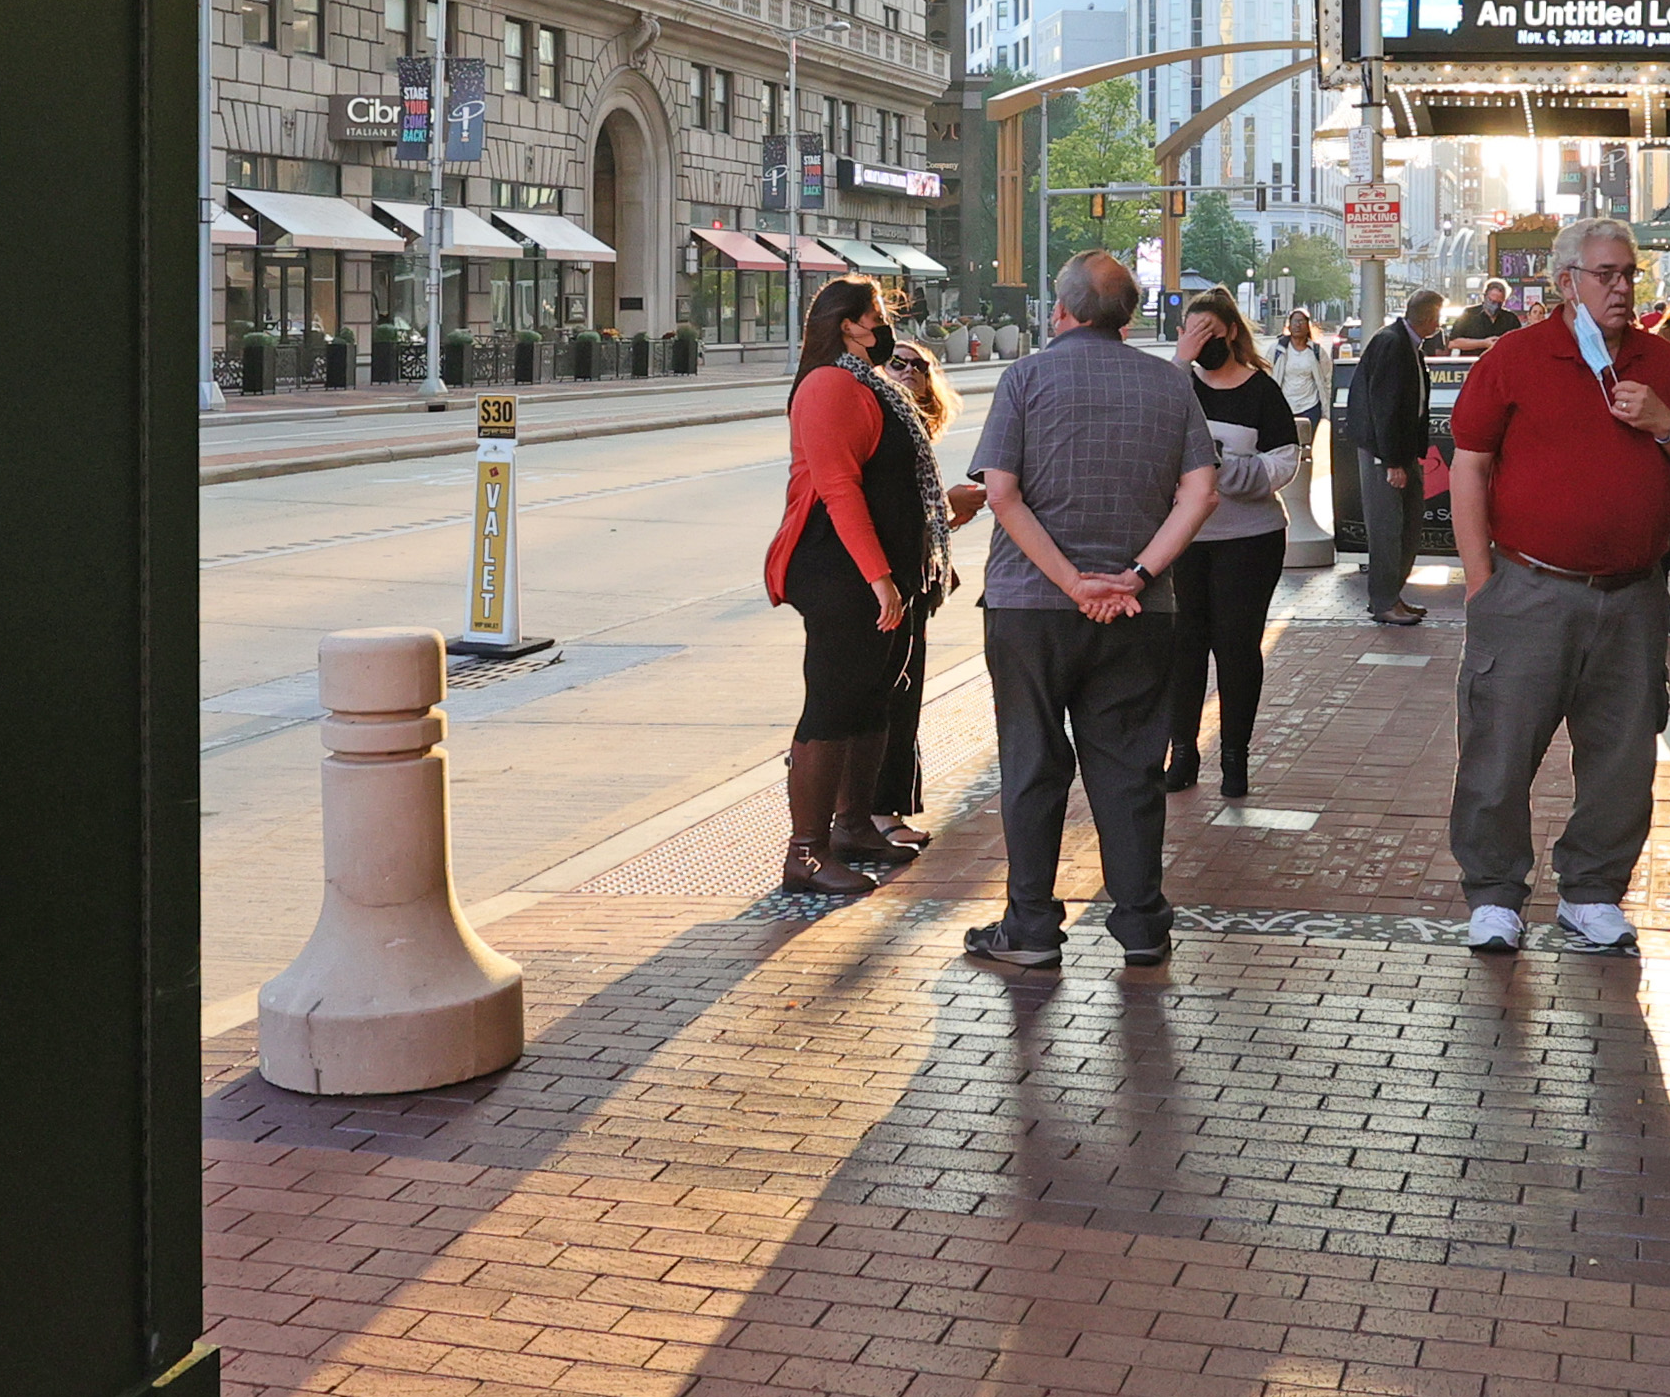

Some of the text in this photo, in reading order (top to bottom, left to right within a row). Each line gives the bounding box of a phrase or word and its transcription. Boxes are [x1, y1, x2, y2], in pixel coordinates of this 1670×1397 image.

[1476, 0, 1517, 26] An
[1523, 0, 1642, 27] Untitled
[1517, 30, 1544, 45] Nov.
[1546, 30, 1560, 47] 6,
[1563, 30, 1596, 45] 2021
[1598, 31, 1613, 45] at
[1615, 30, 1645, 45] 7:30
[403, 87, 429, 100] STAGE
[404, 100, 428, 115] YOUR
[403, 115, 428, 129] COME
[346, 127, 387, 138] ITALIAN
[402, 129, 427, 143] BACK!
[1354, 203, 1390, 213] NO
[1347, 212, 1399, 222] PARKING
[481, 399, 513, 424] $30
[480, 482, 501, 619] VALET
